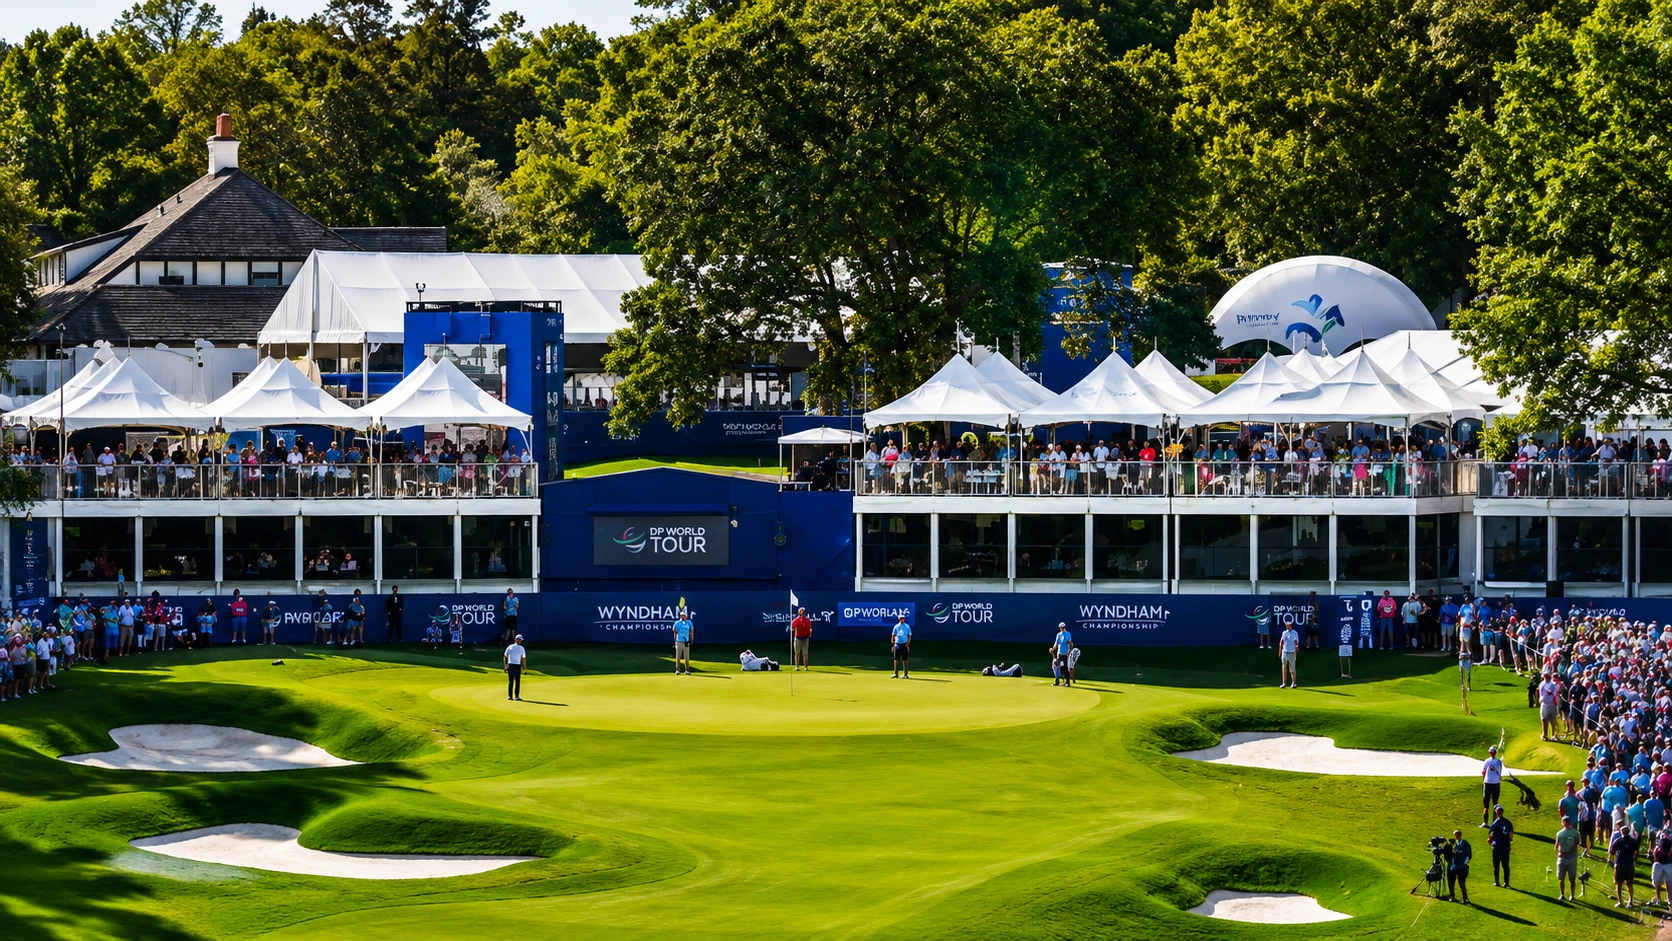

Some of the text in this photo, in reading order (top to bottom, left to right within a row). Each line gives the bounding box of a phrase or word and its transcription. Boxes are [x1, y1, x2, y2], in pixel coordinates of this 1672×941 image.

[649, 527, 706, 536] DP WORLD
[649, 536, 707, 553] TOUR
[597, 605, 688, 619] WYNDHAM
[952, 602, 993, 610] DP WORLD
[1079, 605, 1162, 619] WYNDHAM
[452, 611, 496, 625] TOUR
[952, 610, 994, 623] TOUR
[1082, 622, 1159, 630] CHAMPIONSHIP
